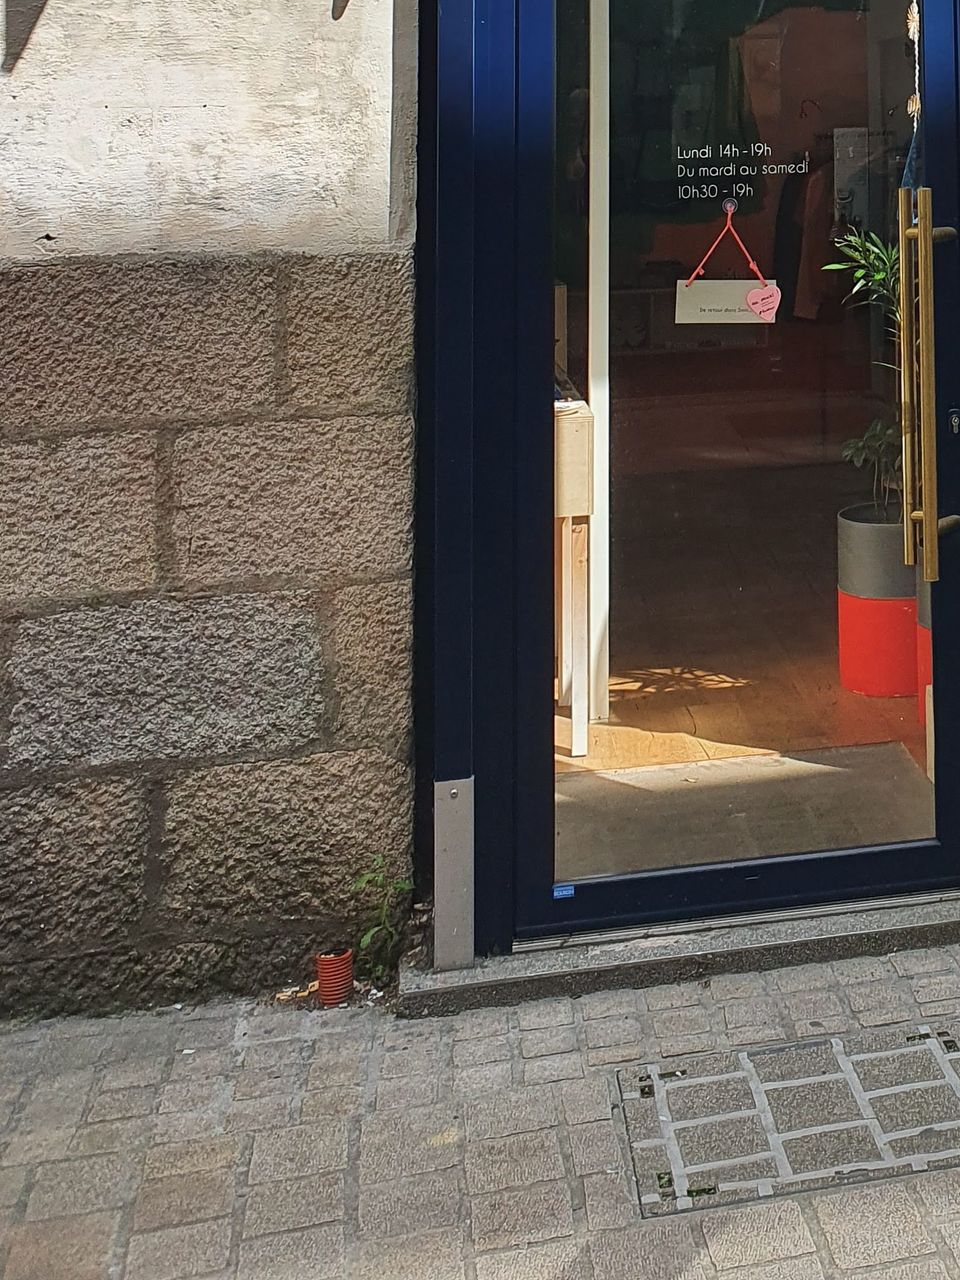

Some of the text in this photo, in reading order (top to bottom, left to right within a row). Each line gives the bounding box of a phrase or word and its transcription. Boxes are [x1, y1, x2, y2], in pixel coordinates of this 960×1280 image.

[677, 145, 712, 159] Lundi
[677, 160, 809, 178] Du mardi au samedi
[678, 184, 718, 199] 10h30
[732, 183, 754, 197] 19h
